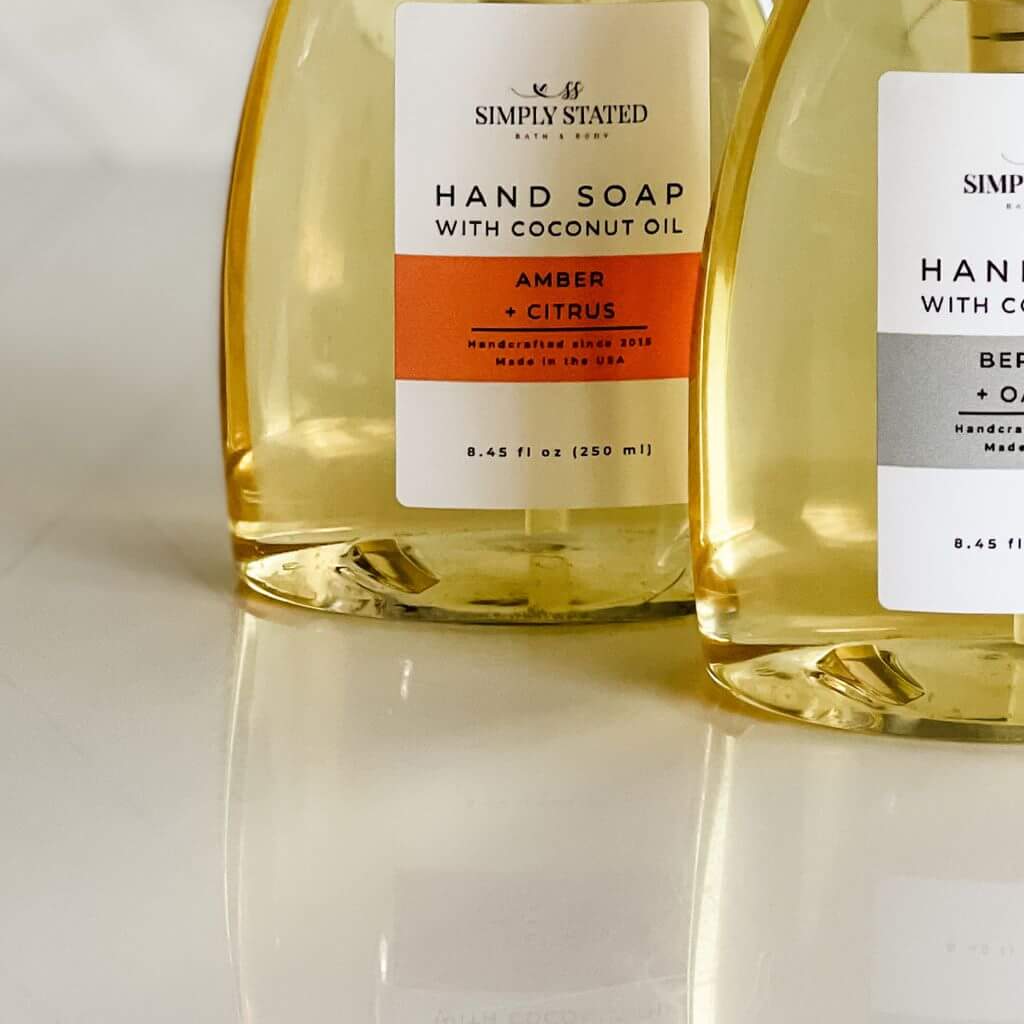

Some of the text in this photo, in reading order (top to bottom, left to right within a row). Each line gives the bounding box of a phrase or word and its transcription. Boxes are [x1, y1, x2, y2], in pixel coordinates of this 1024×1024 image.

[476, 104, 647, 125] SIMPLY STATED
[436, 183, 683, 208] HAND SOAP
[435, 218, 683, 237] WITH COCONUT OIL
[515, 271, 603, 288] AMBER
[504, 302, 615, 320] + CITRUS
[921, 296, 988, 313] WITH
[467, 338, 565, 350] Handcrafted
[976, 387, 989, 401] +
[466, 443, 652, 460] 8.45 fl oz (250 ml)
[953, 537, 997, 550] 8.45
[1008, 537, 1022, 550] fl
